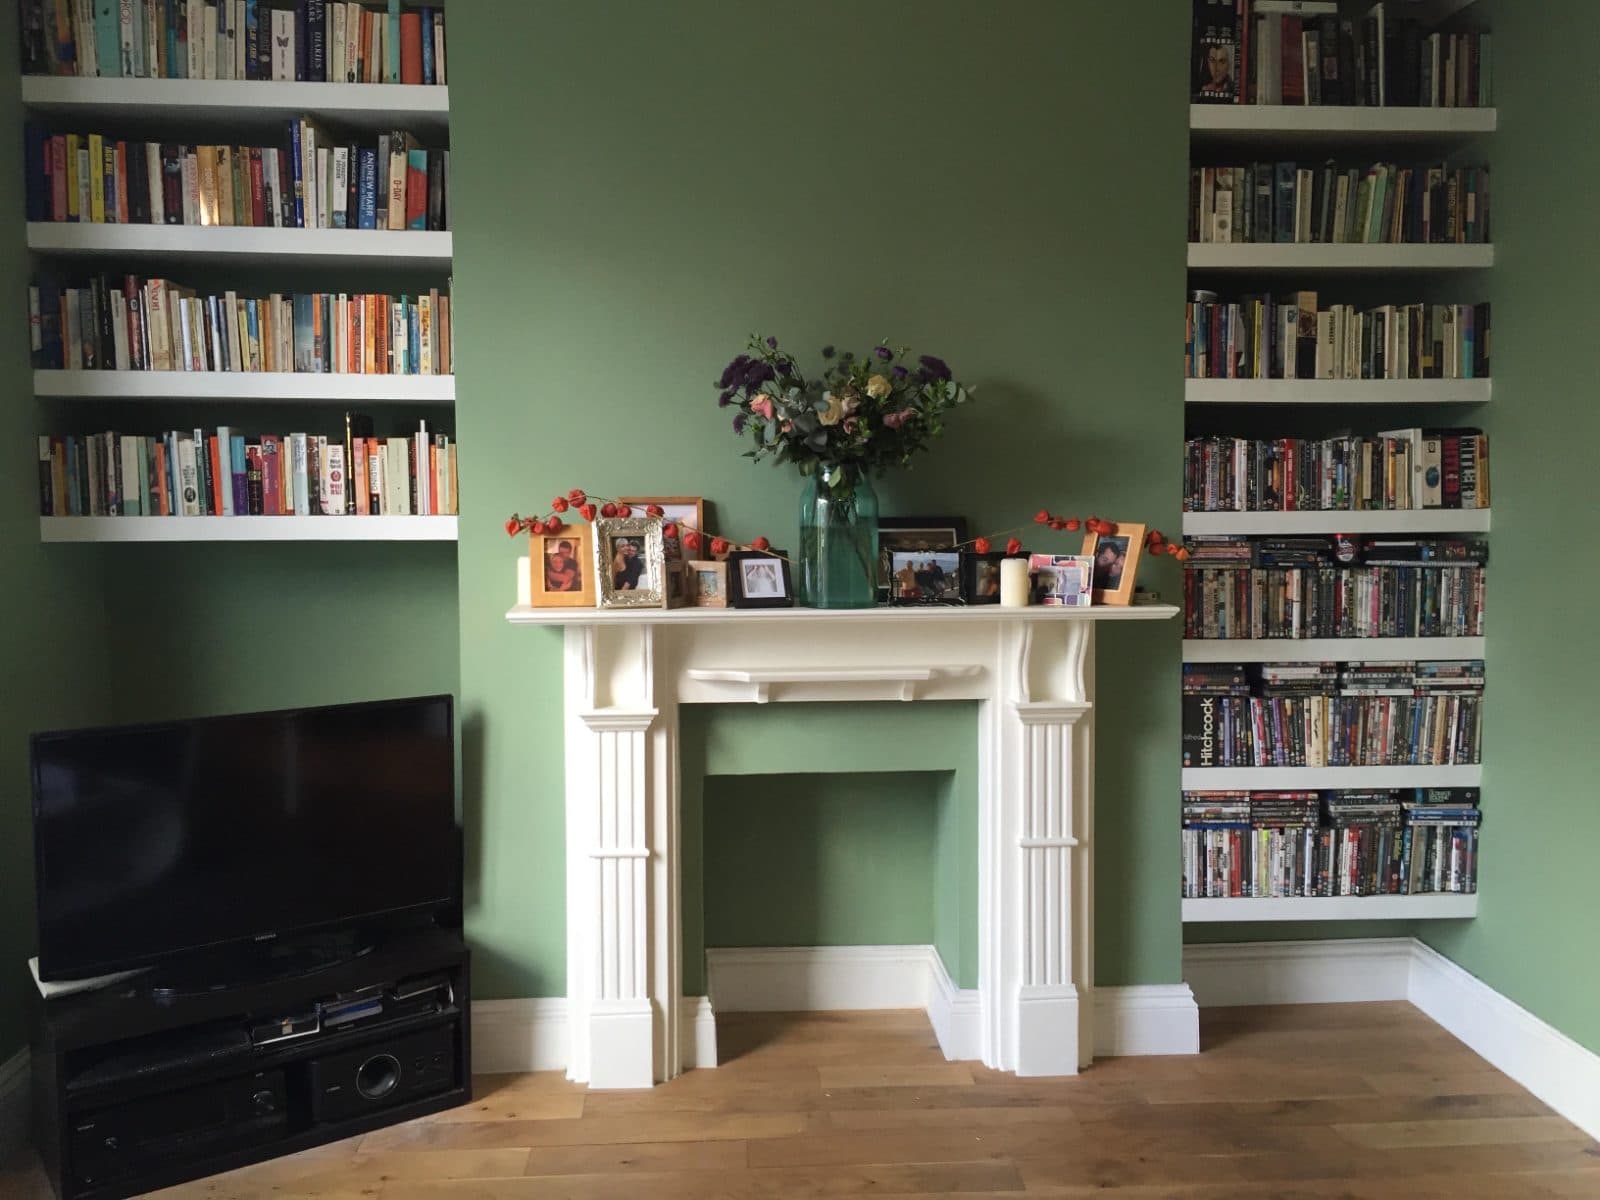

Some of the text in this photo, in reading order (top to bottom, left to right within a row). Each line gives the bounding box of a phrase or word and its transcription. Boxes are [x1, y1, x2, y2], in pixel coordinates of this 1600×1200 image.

[308, 0, 316, 23] LARK
[314, 31, 322, 69] DIARIES
[366, 151, 374, 217] ANDREW MARR
[393, 179, 402, 202] D-DAY
[1460, 438, 1475, 492] HITLER
[1200, 697, 1213, 766] Hitchcock
